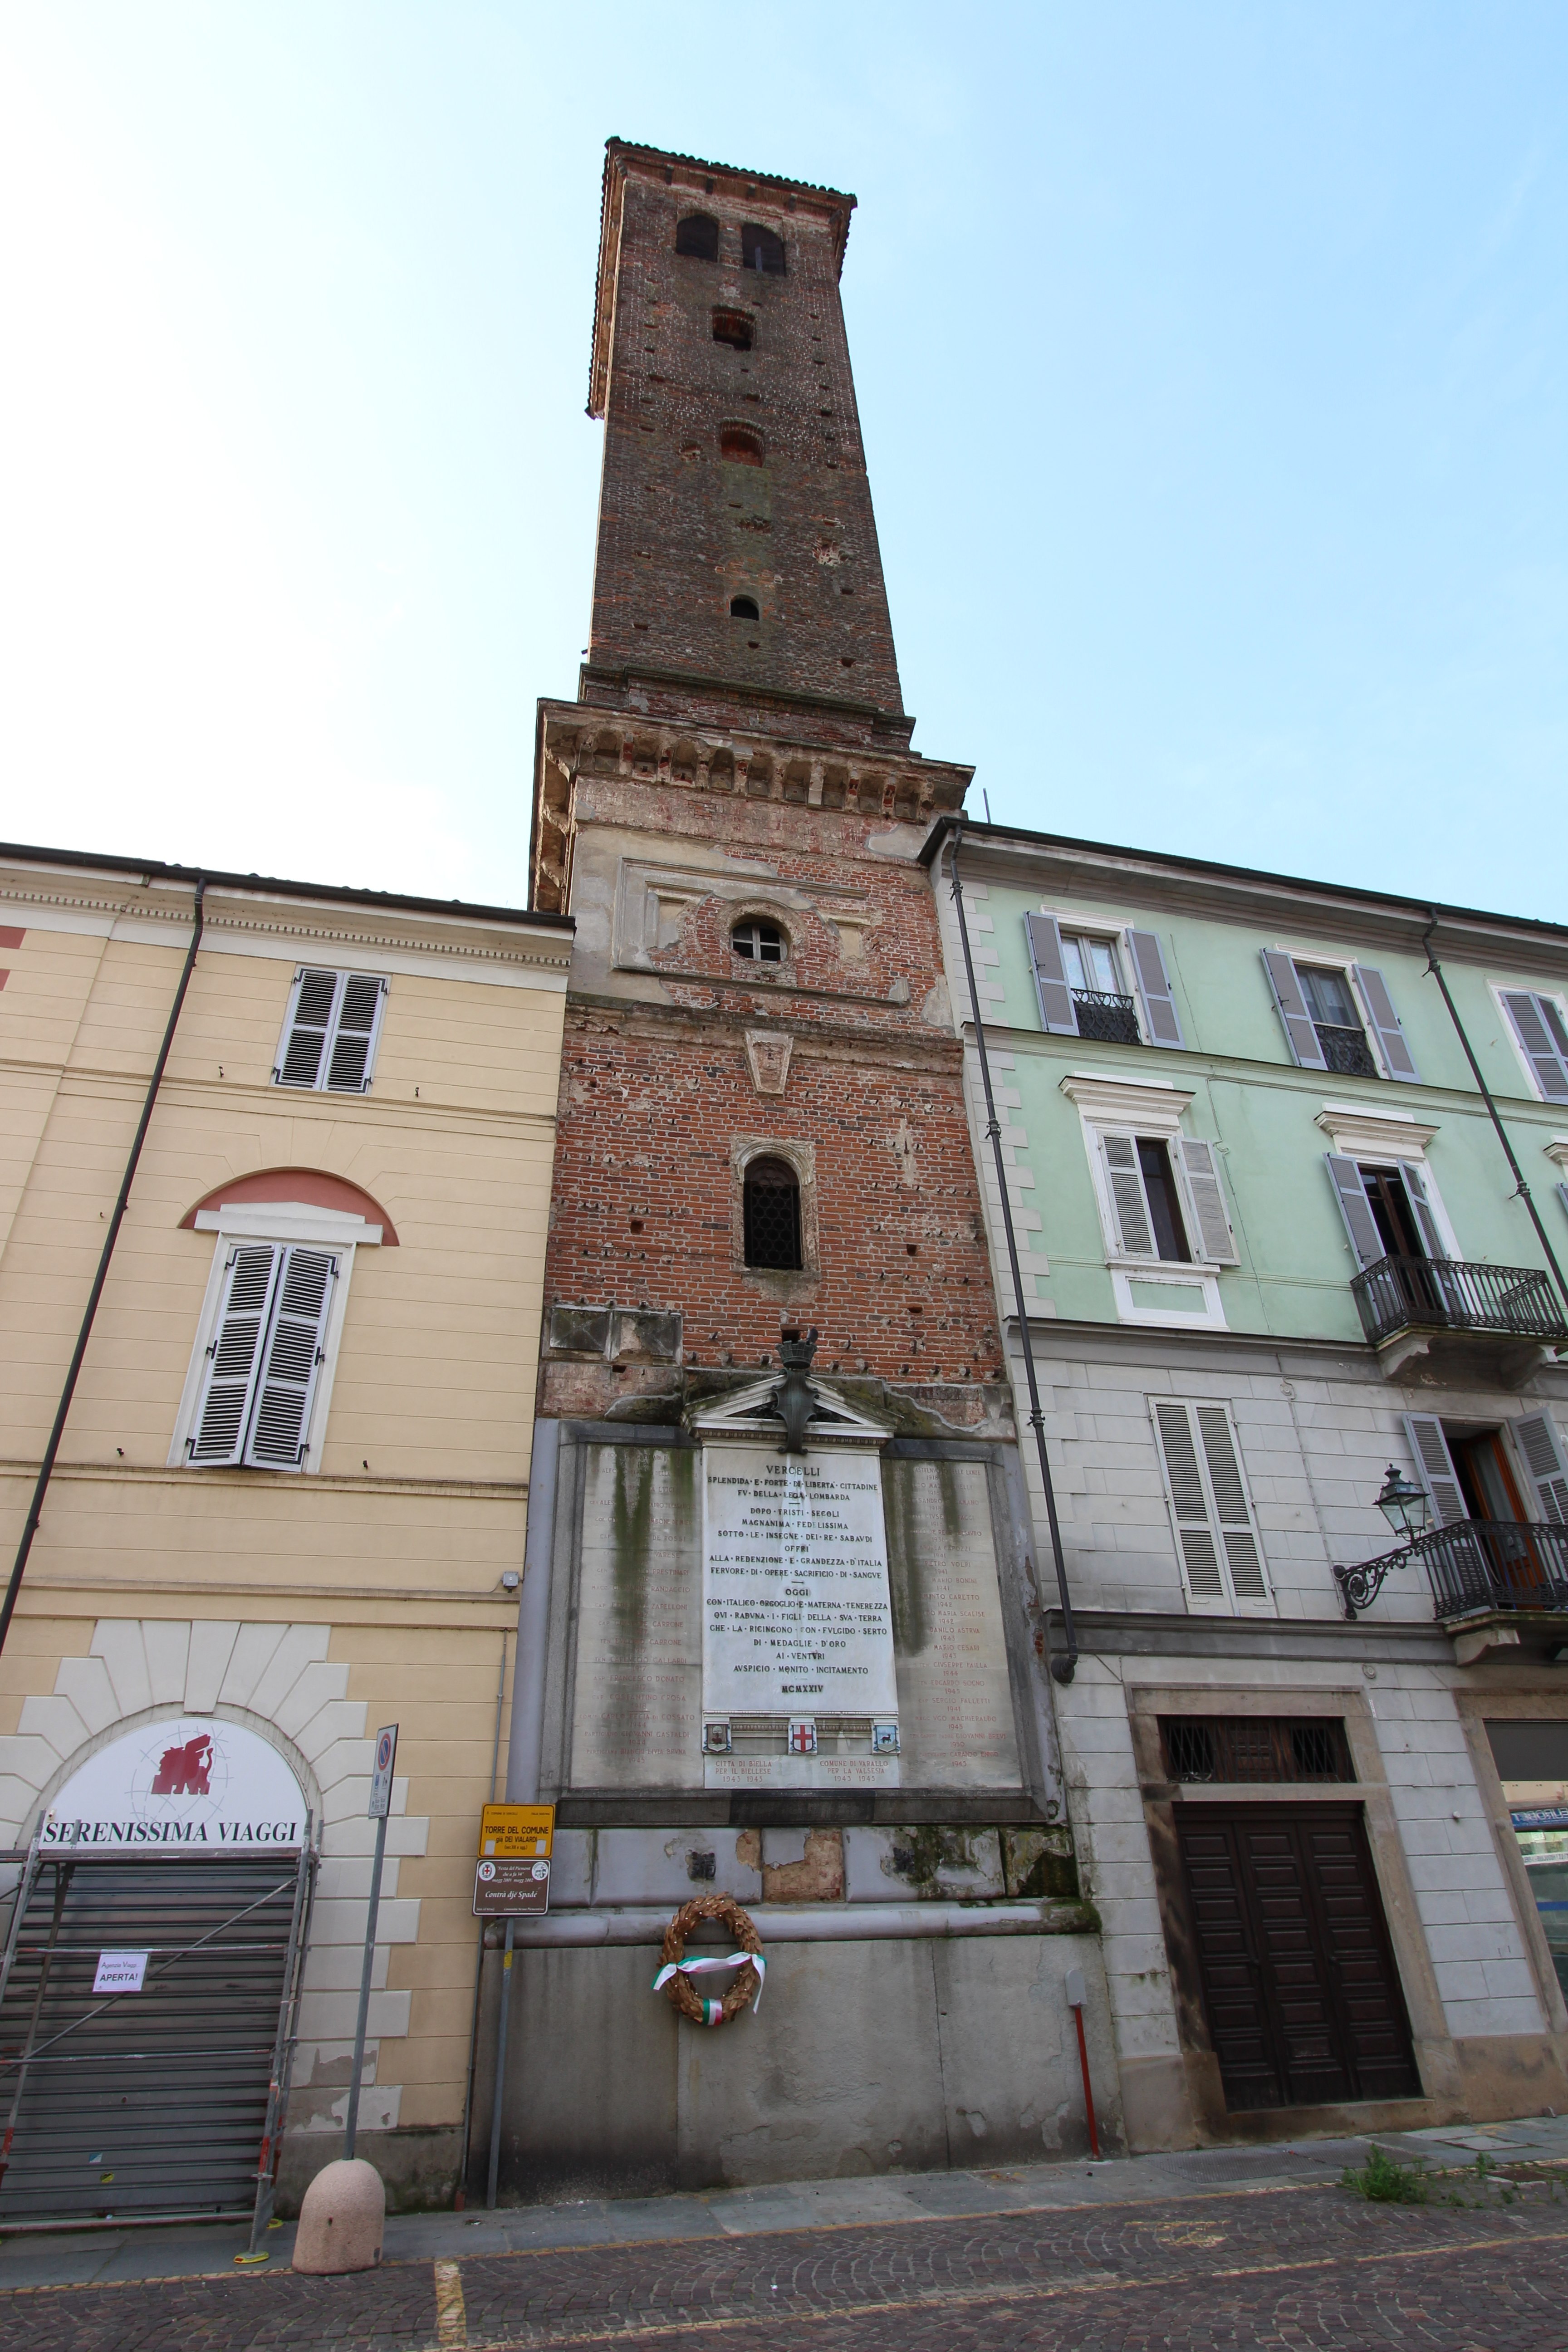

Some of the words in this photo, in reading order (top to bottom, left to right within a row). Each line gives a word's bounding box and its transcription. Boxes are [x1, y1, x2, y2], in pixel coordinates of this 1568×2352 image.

[766, 1465, 820, 1475] VERCELLI
[708, 1476, 749, 1485] SPLENDIDA
[742, 1519, 790, 1527] MAGNANIMA
[797, 1521, 848, 1529] FEDELISSIMA
[735, 1555, 783, 1563] REDENZIONE
[850, 1558, 882, 1566] D'ITALIA
[43, 1822, 208, 1842] SERENISSIMA
[218, 1822, 298, 1841] VIAGGI
[100, 1973, 138, 1981] APERTA!
